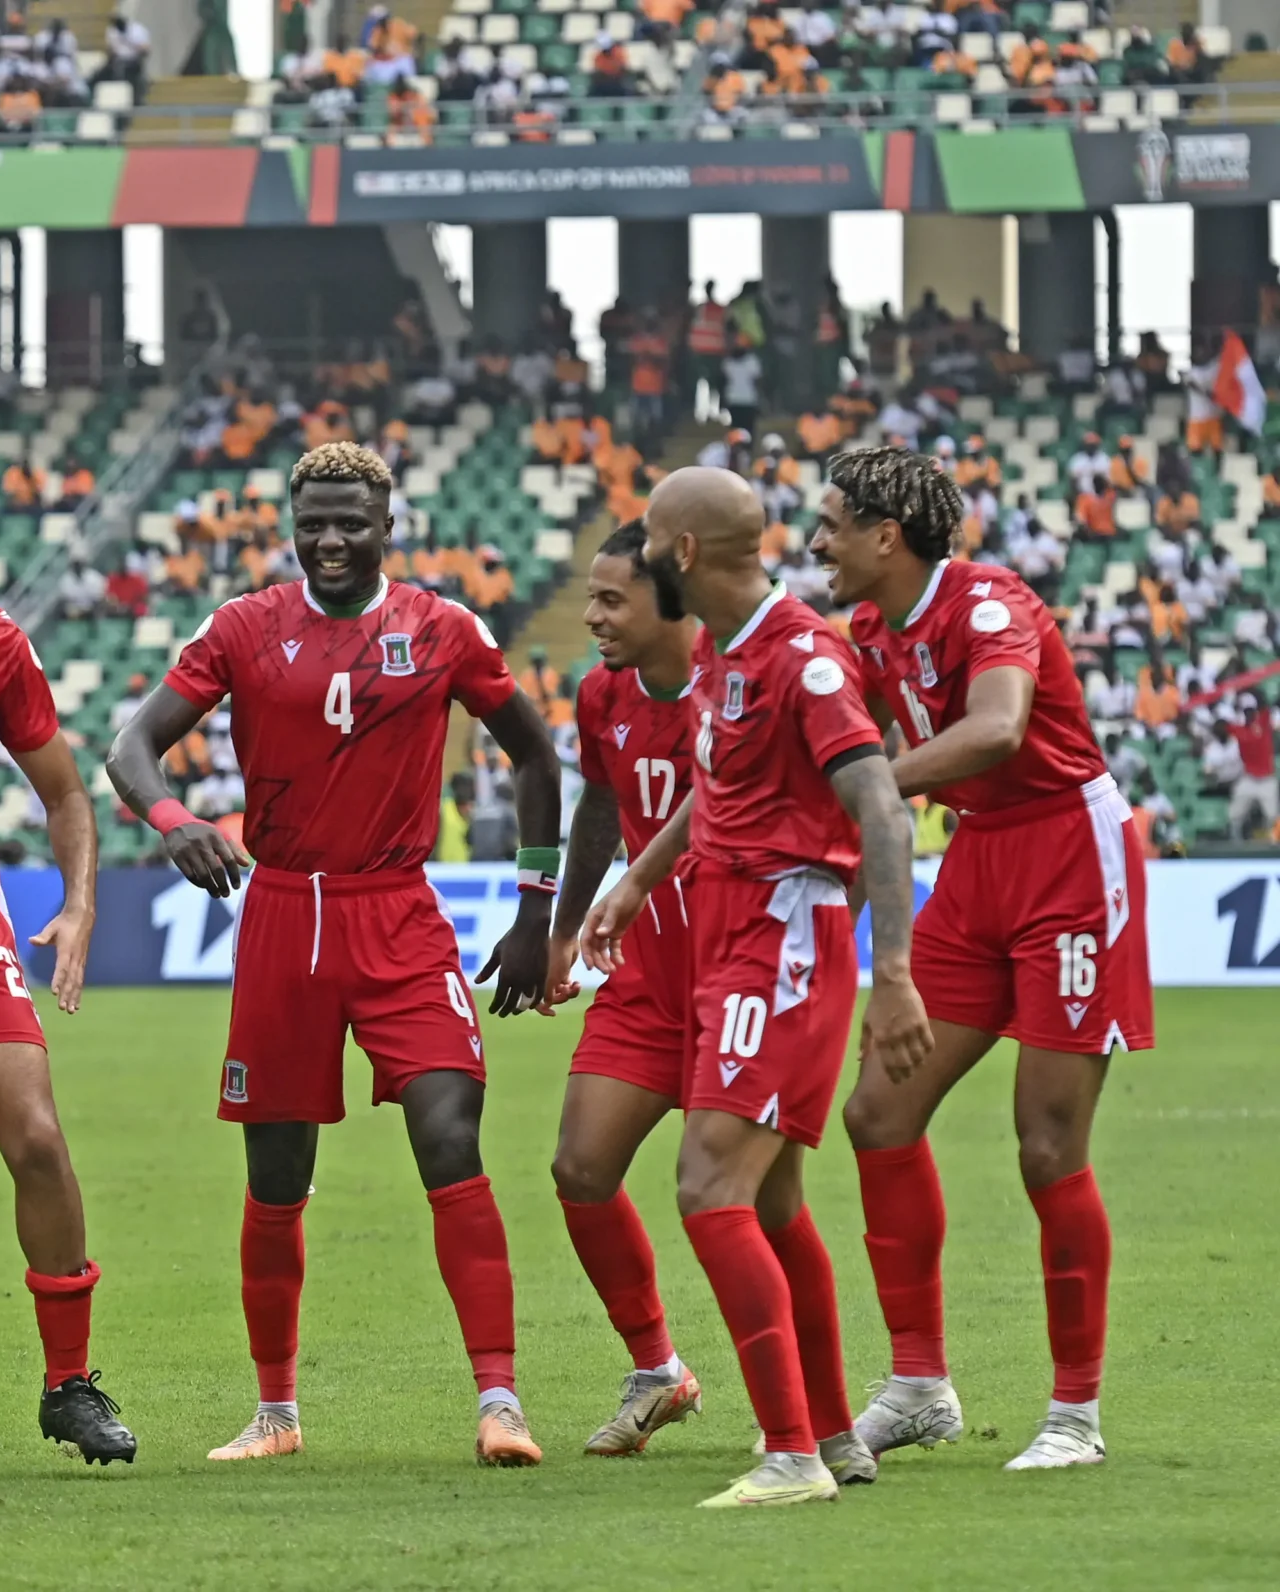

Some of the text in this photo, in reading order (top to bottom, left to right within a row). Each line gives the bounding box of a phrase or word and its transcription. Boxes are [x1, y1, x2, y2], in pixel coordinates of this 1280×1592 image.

[324, 671, 354, 734] 4
[634, 757, 676, 820] 17
[1055, 933, 1098, 997] 16
[444, 971, 476, 1027] 4
[718, 993, 768, 1058] 10
